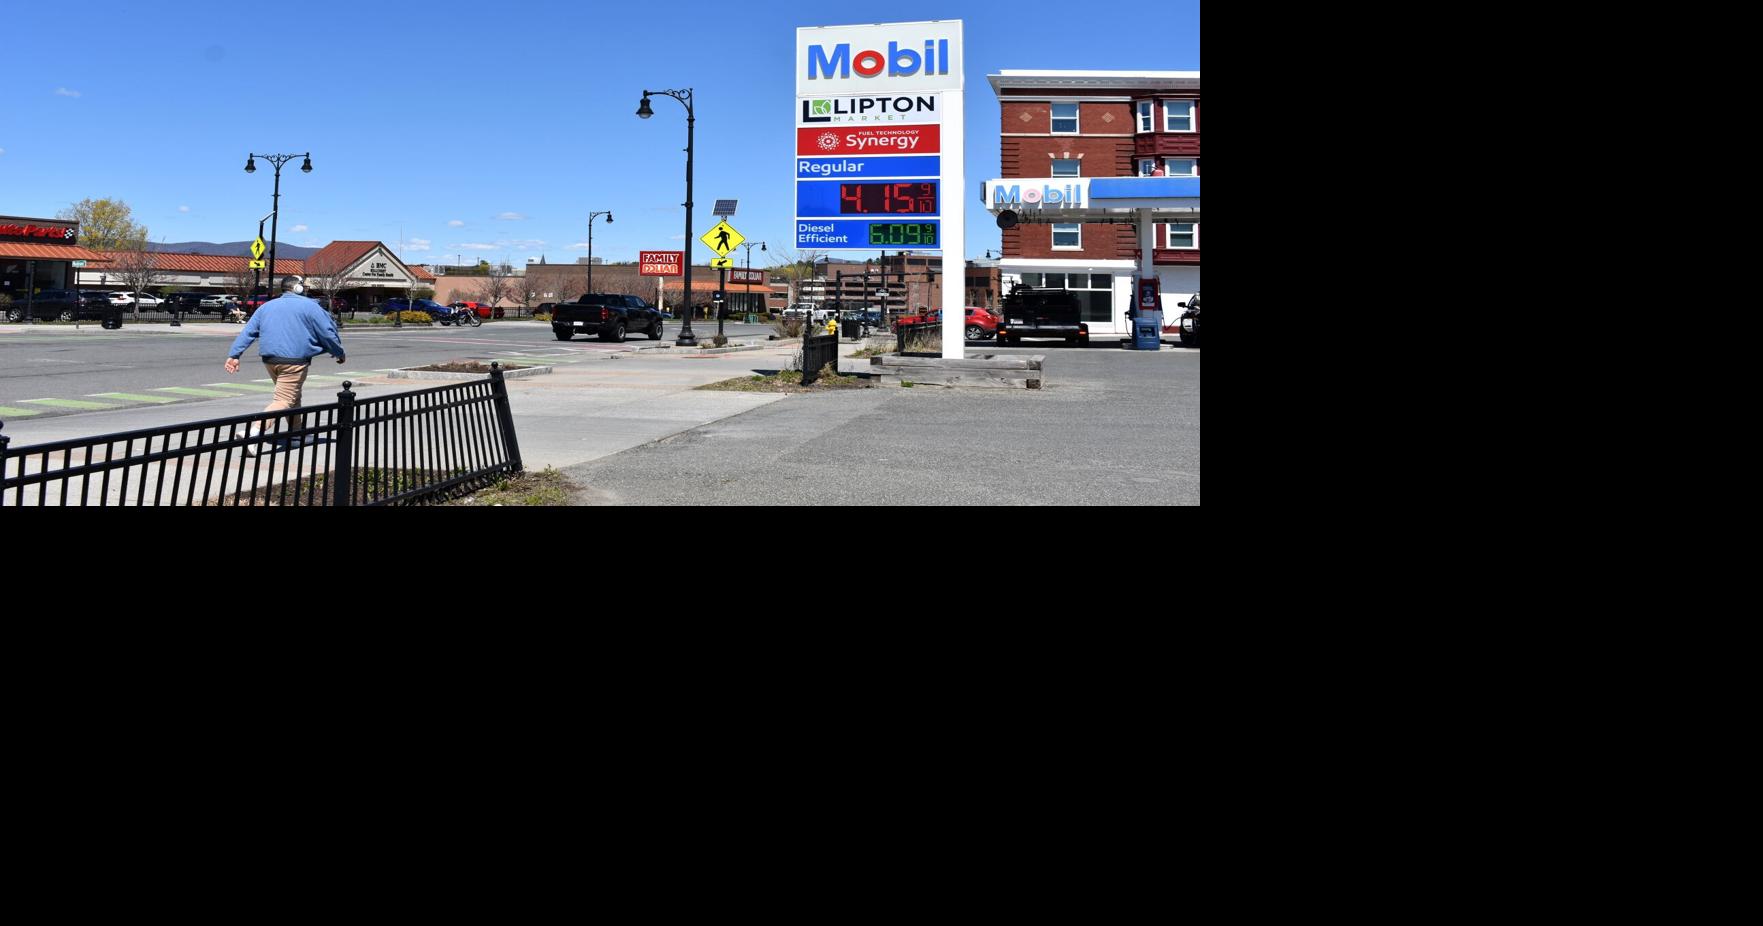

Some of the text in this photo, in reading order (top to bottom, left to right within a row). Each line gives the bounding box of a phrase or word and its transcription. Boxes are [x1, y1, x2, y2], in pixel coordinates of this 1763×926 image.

[807, 39, 949, 80] Mobil
[834, 96, 935, 114] LIPTON
[846, 134, 919, 149] Synergy
[799, 160, 864, 176] Regular
[995, 184, 1081, 204] Mobil
[798, 224, 834, 233] Diesel
[798, 234, 848, 244] Efficient
[642, 253, 679, 263] FAMILY
[642, 263, 679, 273] DOLLAR
